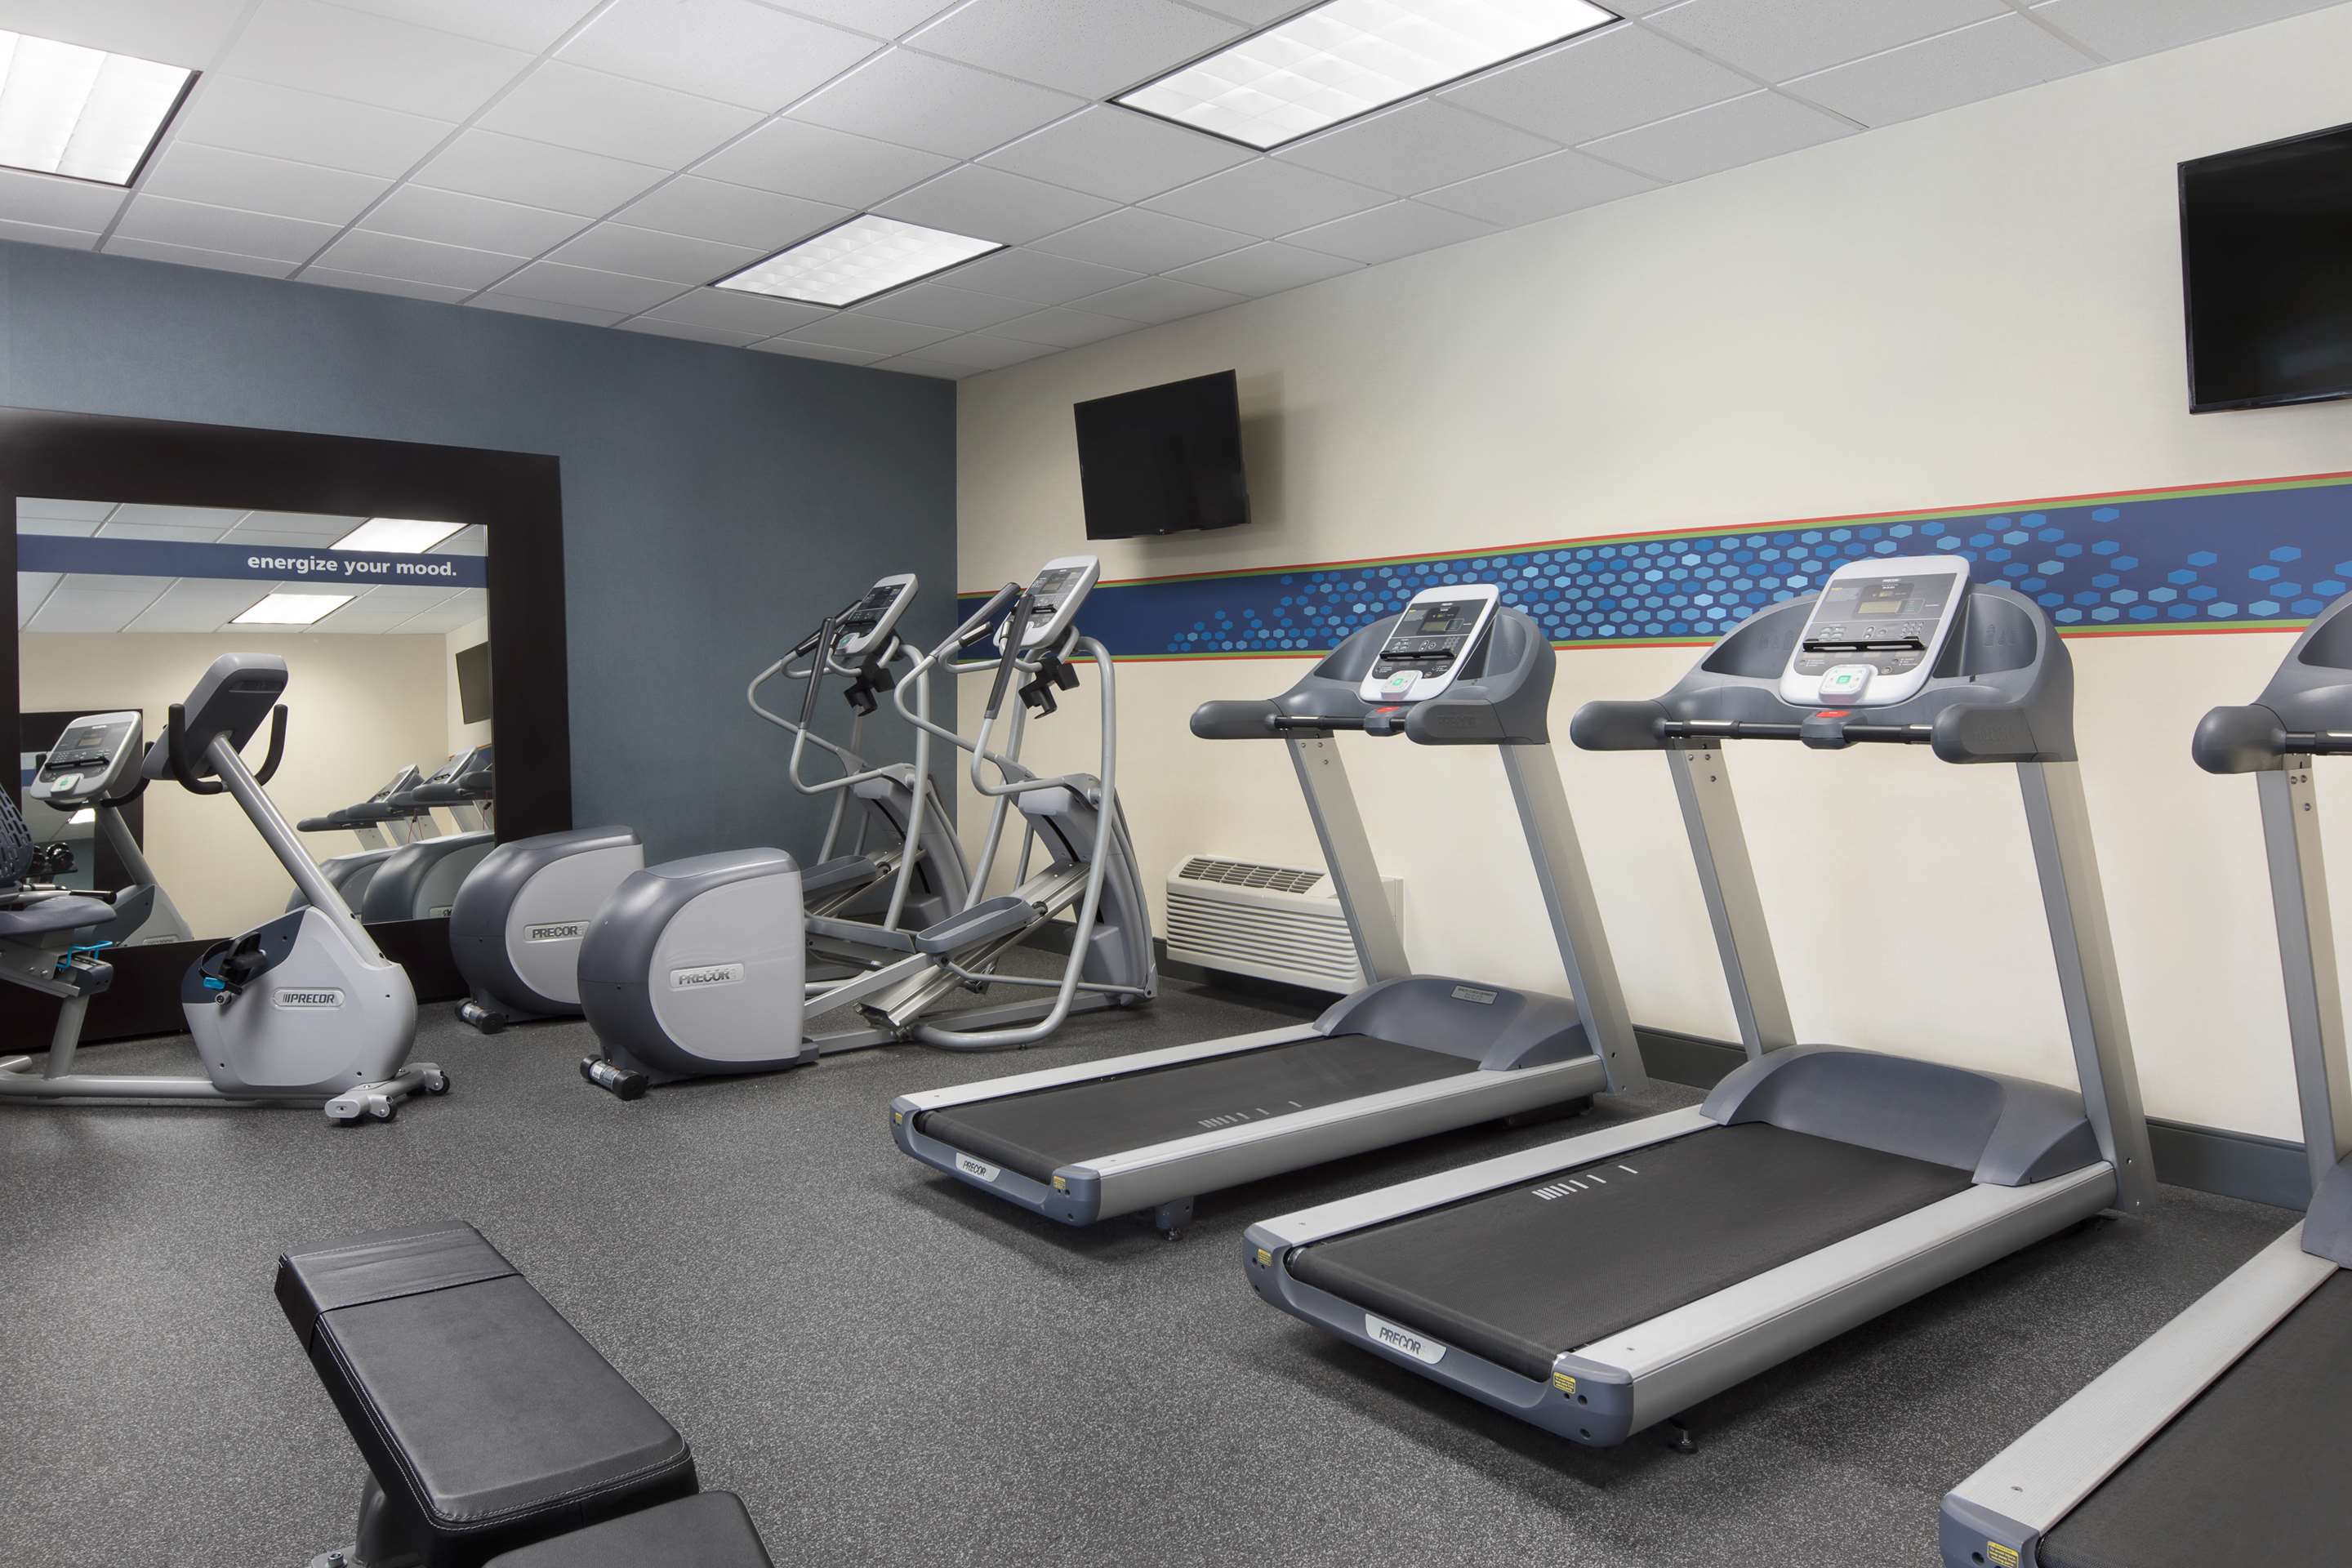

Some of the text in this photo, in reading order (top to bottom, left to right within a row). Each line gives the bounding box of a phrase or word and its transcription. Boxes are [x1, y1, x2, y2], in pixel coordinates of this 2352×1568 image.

[247, 556, 457, 576] energize your mood.
[532, 926, 578, 938] PRECOR
[679, 969, 730, 985] PRECOR
[290, 994, 335, 1004] PRECOR
[963, 1160, 987, 1177] PRECOR
[1379, 1327, 1422, 1354] PRECOR
